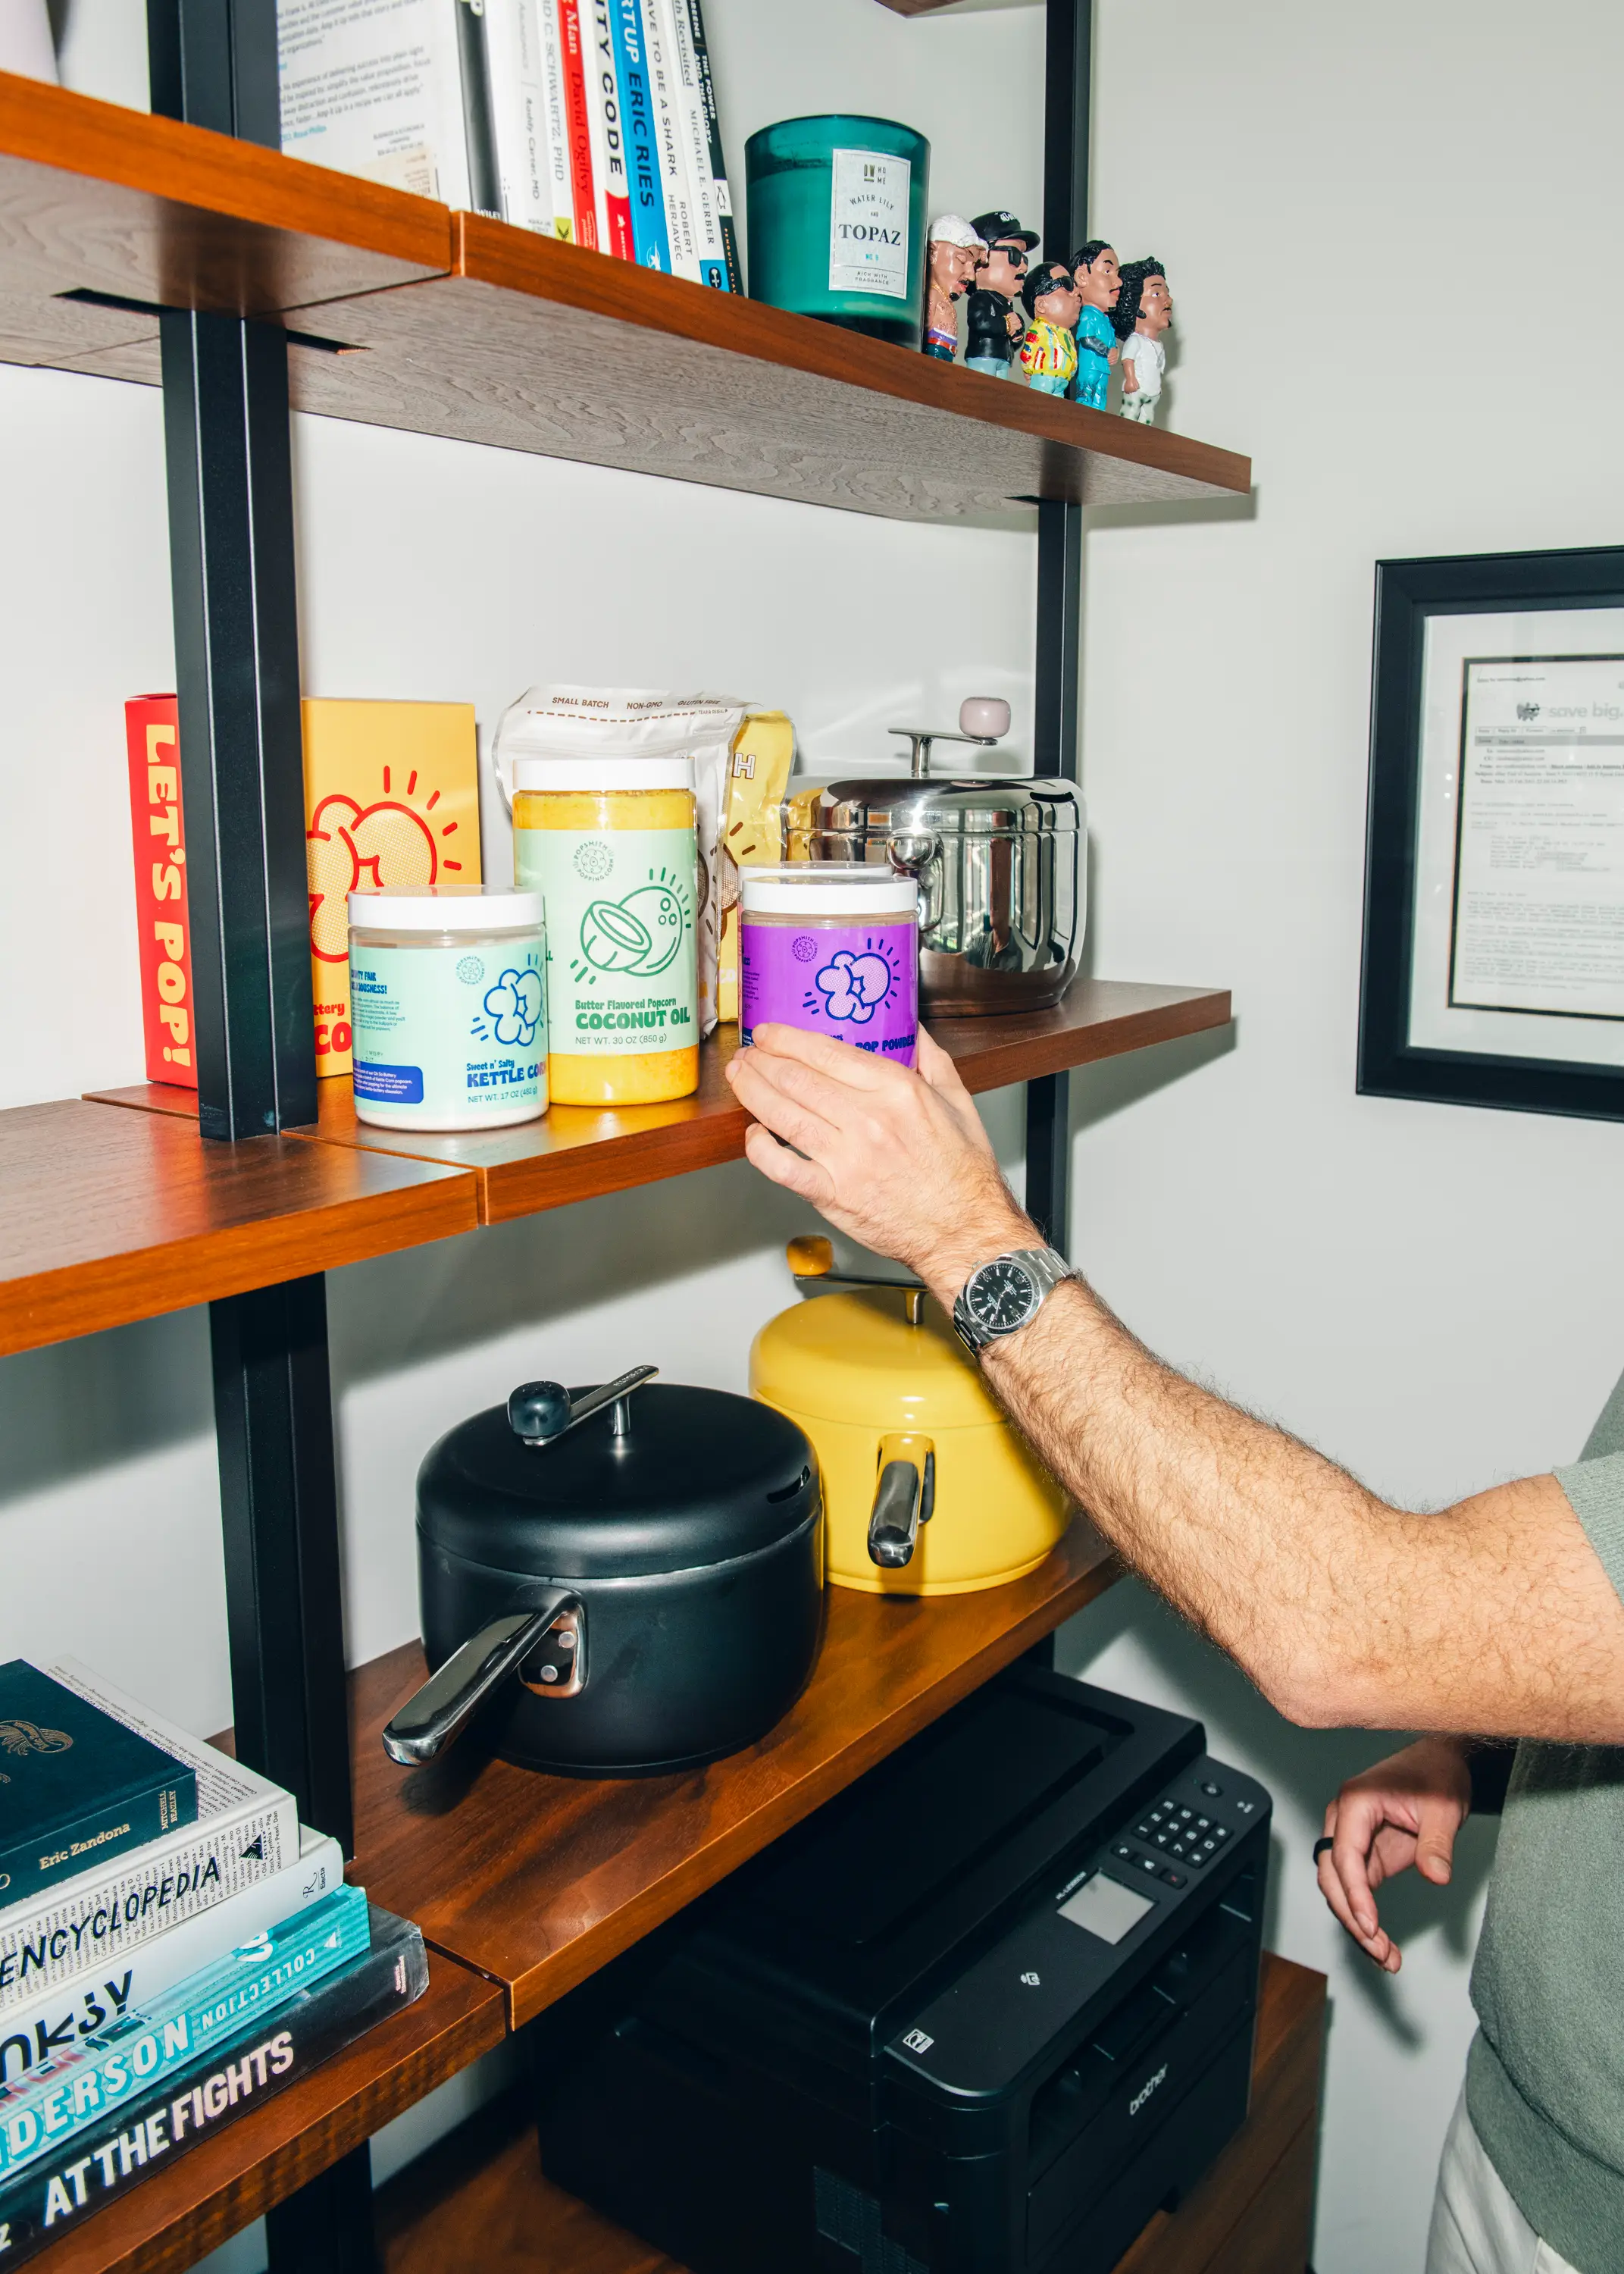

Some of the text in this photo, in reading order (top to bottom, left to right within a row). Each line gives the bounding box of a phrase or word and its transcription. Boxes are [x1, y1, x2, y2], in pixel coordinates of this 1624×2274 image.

[652, 39, 662, 64] TO
[677, 20, 695, 88] Revisited
[656, 69, 667, 93] BE
[702, 54, 717, 121] THE POWER
[565, 8, 590, 198] Man David Ogilvy
[628, 71, 648, 139] ERIC
[659, 98, 668, 110] A
[602, 71, 623, 176] CODE
[702, 105, 713, 145] GLORY
[662, 116, 678, 177] SHARK
[553, 146, 565, 182] PHD
[635, 144, 655, 208] RIES
[690, 108, 706, 173] MICHAEL
[700, 191, 715, 245] GERBER
[850, 194, 895, 211] WATER LILY
[668, 193, 693, 262] ROBERT HERJAVEC
[838, 224, 901, 246] TOPAZ
[855, 277, 890, 285] FRAGRANCE
[552, 697, 610, 709] SMALL BATCH
[626, 700, 663, 710] NON-GMO
[1548, 706, 1588, 719] save
[732, 752, 756, 780] H
[573, 840, 609, 860] POPSMITH
[146, 724, 191, 1068] LET'S POP!
[364, 971, 377, 982] FAIR
[574, 998, 677, 1010] Butter Flavored Popcorn
[575, 1007, 691, 1030] COCONUT OIL
[314, 1022, 352, 1056] CO
[574, 1032, 668, 1045] NET WT. 30 OZ (850 g)
[466, 1061, 488, 1072] Sweet
[498, 1059, 515, 1070] Salty
[467, 1067, 525, 1088] KETTLE
[468, 1095, 483, 1104] NET
[484, 1093, 500, 1103] WT.
[501, 1092, 509, 1100] 17
[510, 1089, 520, 1098] OZ
[158, 1789, 169, 1831] MITCHELL
[168, 1790, 179, 1824] BEAZLEY
[39, 1822, 131, 1871] Eric Zandona
[0, 1856, 221, 1990] ENCYCLOPEDIA
[202, 1947, 316, 2031] COLLECTION
[1129, 2063, 1169, 2116] brother
[43, 2030, 294, 2228] AT THE FIGHTS
